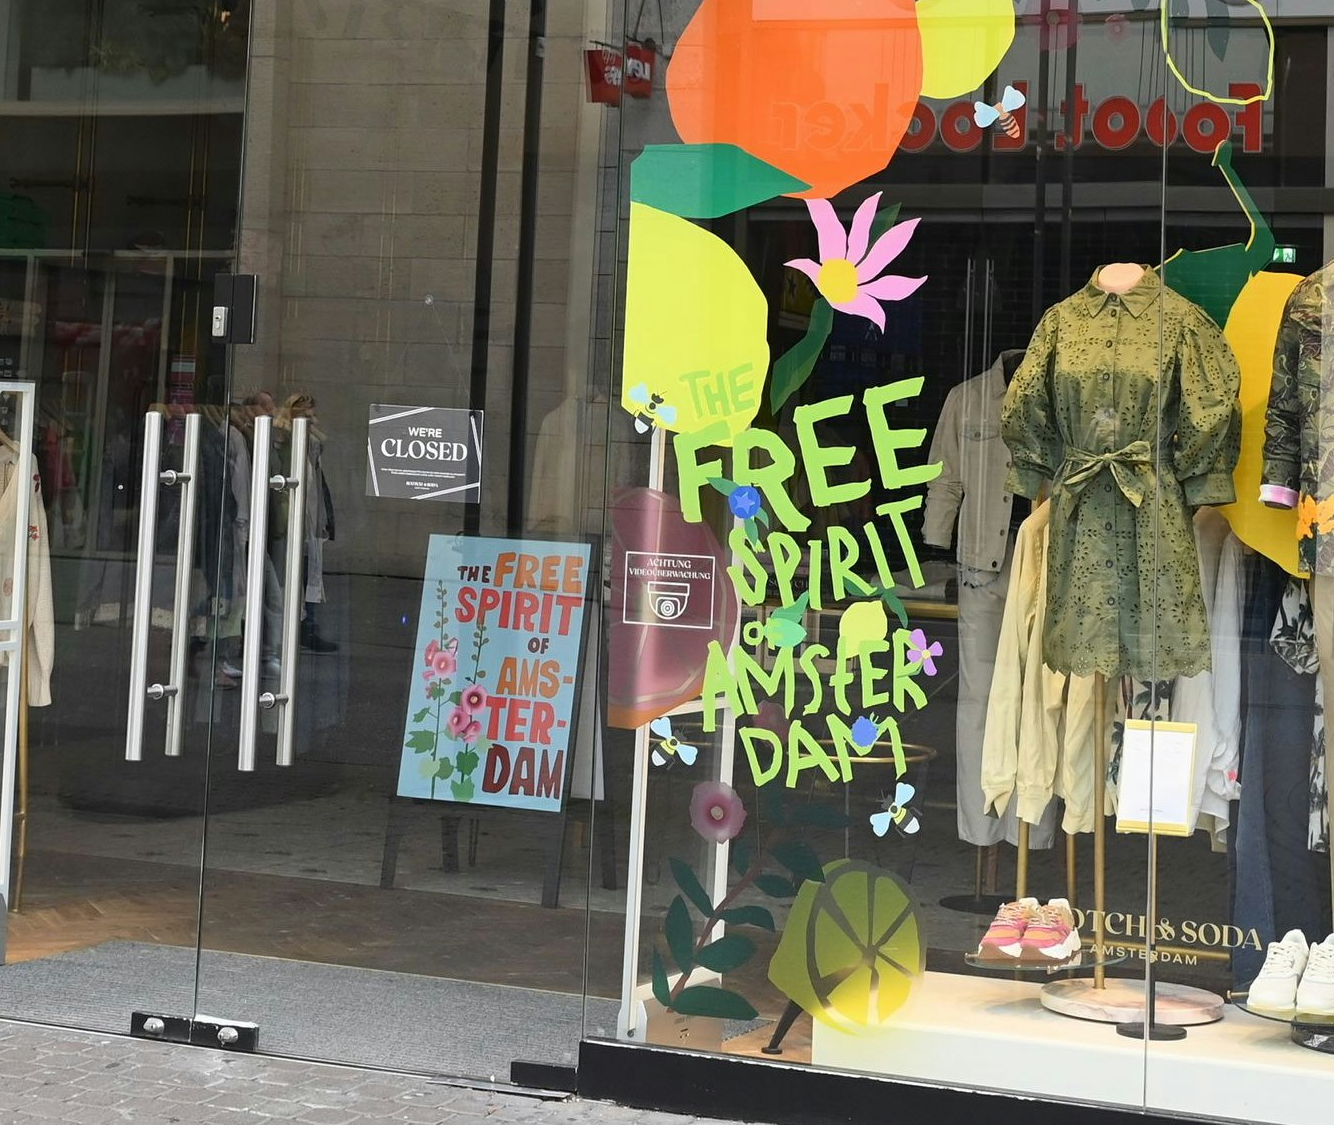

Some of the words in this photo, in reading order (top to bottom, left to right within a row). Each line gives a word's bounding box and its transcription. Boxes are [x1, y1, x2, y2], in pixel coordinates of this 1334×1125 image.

[679, 361, 755, 420] THE
[380, 438, 469, 463] CLOSED
[408, 427, 443, 439] WE'RE
[672, 376, 944, 533] FREE
[457, 565, 492, 583] THE
[494, 551, 584, 593] FREE
[629, 566, 711, 580] VIDEOÜBERWACHUNG
[647, 558, 692, 570] ACHTUNG
[726, 495, 926, 611] SPIRIT
[455, 586, 583, 636] SPIRIT
[527, 637, 550, 655] OF
[496, 656, 575, 699] AMS-
[485, 696, 567, 745] TER-
[482, 743, 565, 801] DAM
[738, 713, 908, 789] DAM
[1089, 945, 1198, 966] AMSTERDAM
[1181, 920, 1263, 951] SODA
